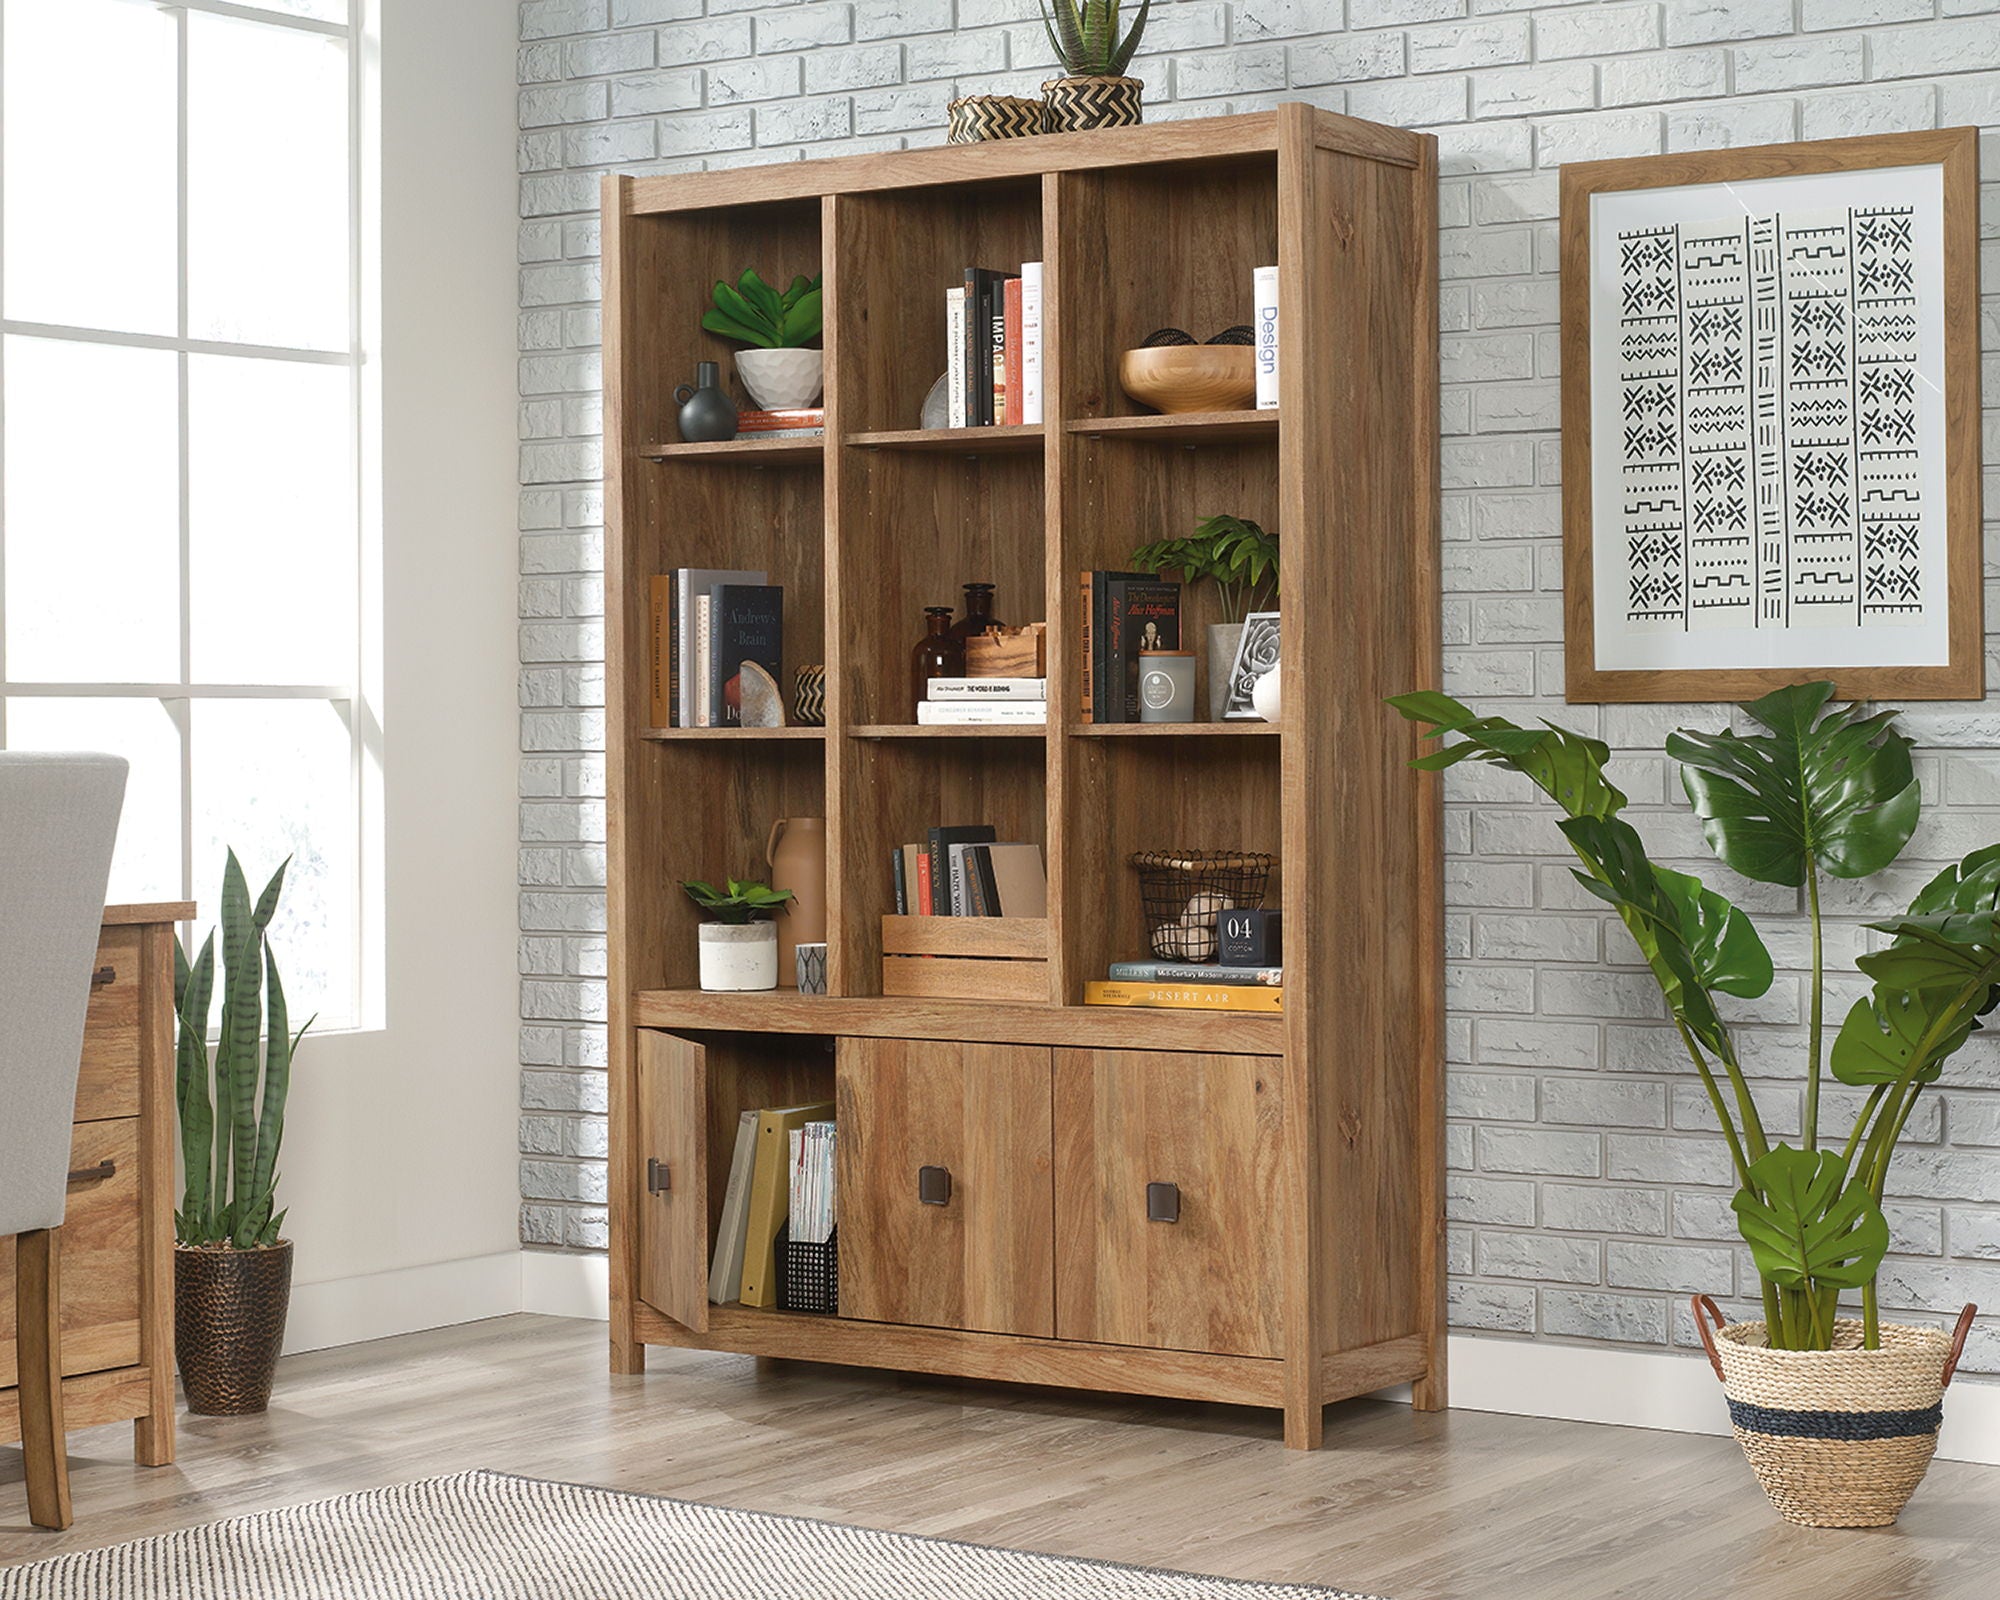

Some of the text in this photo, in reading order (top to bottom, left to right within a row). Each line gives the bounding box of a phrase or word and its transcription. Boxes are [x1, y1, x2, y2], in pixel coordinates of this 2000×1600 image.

[992, 316, 1004, 370] IMPACT
[1259, 306, 1278, 374] Design
[729, 607, 776, 625] Andrew's
[738, 631, 767, 647] Brain
[1228, 917, 1252, 939] 04
[1197, 970, 1223, 978] Modern
[1148, 990, 1230, 1003] DESERT AIR
